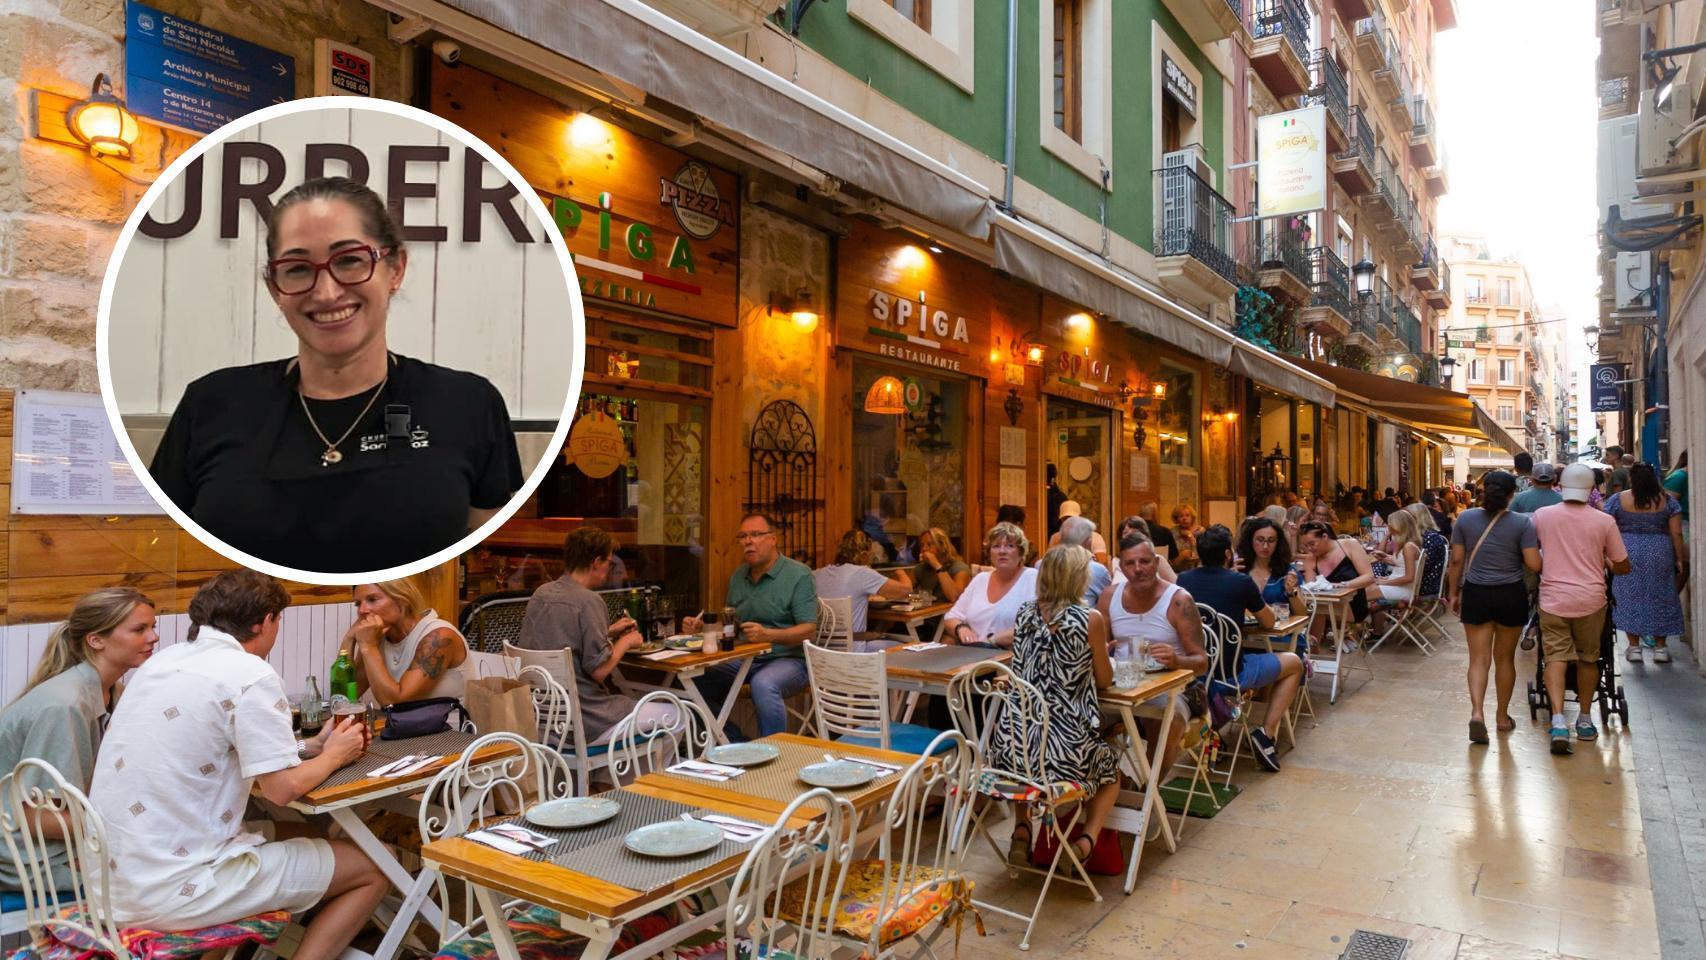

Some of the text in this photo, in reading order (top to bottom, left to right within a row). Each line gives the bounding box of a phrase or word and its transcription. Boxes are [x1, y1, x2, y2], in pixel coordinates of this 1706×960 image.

[163, 16, 223, 42] Concatedral
[163, 26, 176, 35] de
[178, 30, 197, 43] San
[200, 38, 235, 57] Nicolás
[163, 59, 202, 78] Archivo
[204, 71, 250, 93] Municipal
[335, 53, 368, 76] SDS
[163, 88, 198, 104] Centro
[200, 98, 211, 109] 14
[170, 100, 180, 108] de
[181, 102, 215, 118] Recursos
[660, 177, 736, 229] PIZZA
[880, 343, 961, 372] RESTAURANTE
